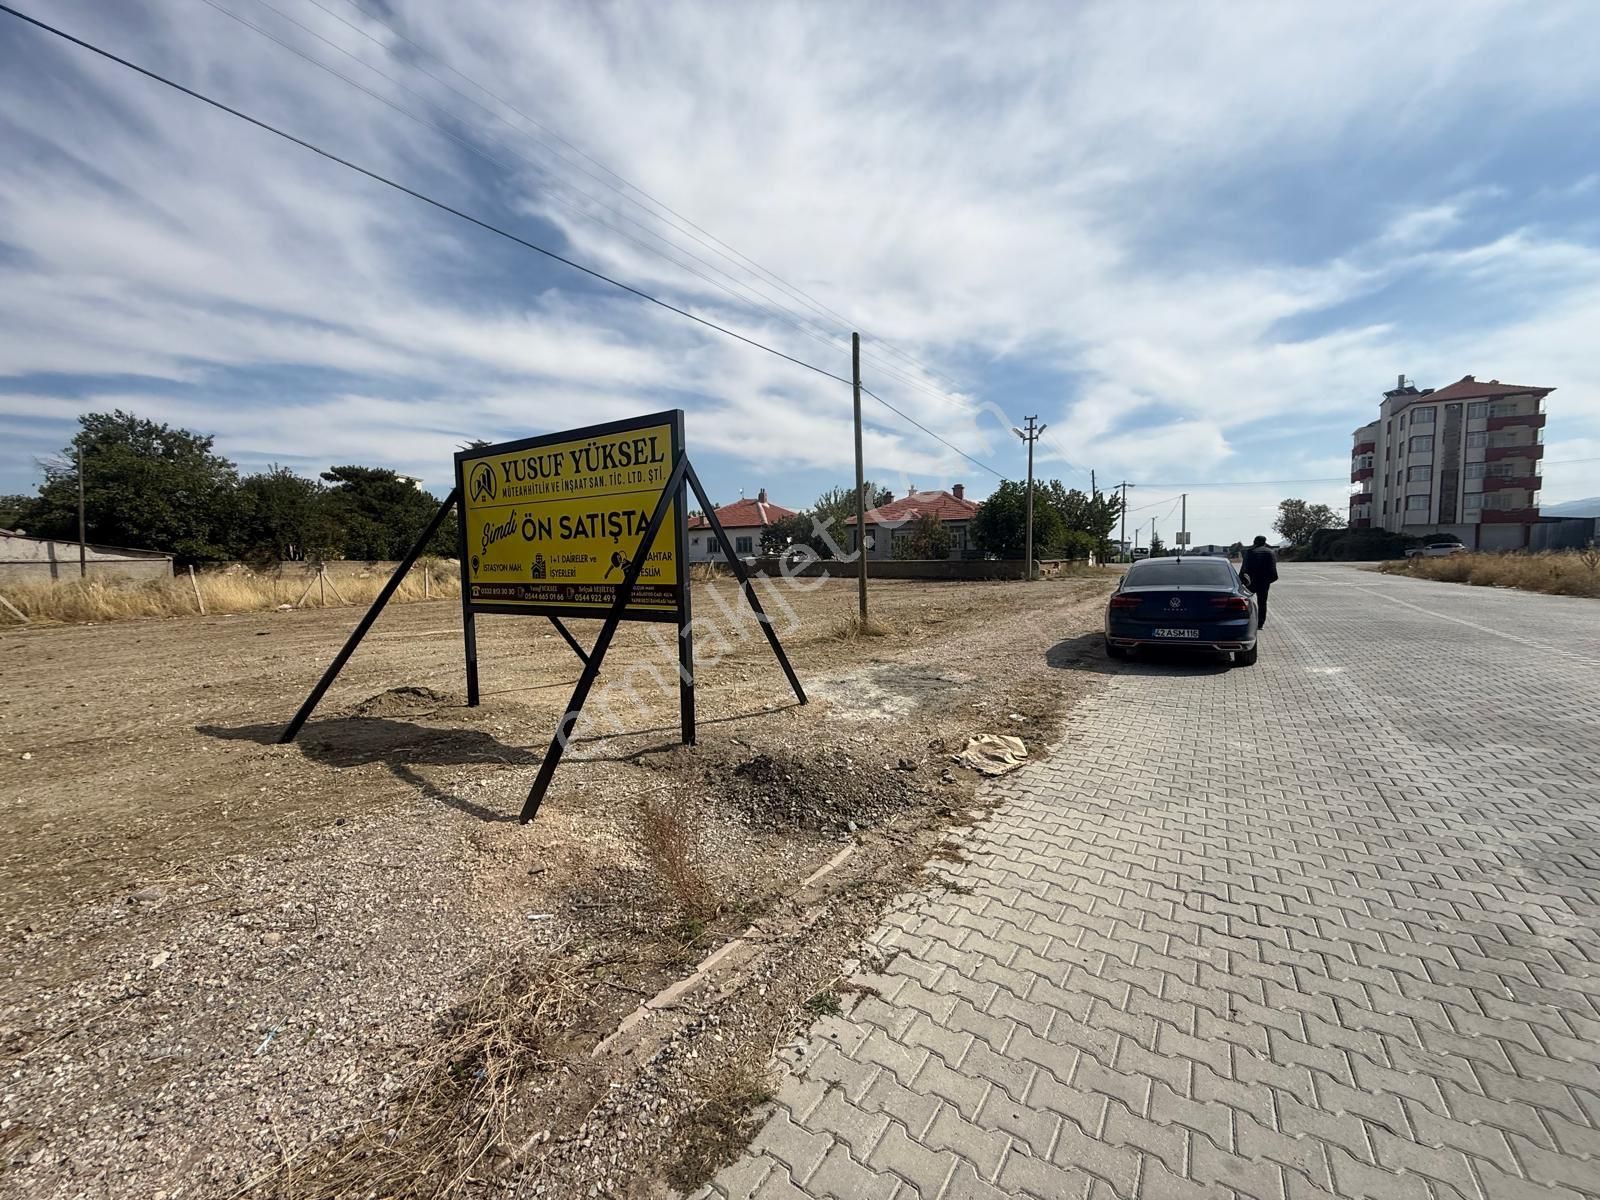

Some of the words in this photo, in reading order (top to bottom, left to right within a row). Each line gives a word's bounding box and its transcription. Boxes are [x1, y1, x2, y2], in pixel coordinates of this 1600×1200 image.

[501, 452, 565, 482] YUSUF
[569, 436, 665, 474] YÜKSEL
[502, 480, 550, 498] MÜTEAHHİTLİK
[551, 480, 560, 492] VE
[561, 478, 588, 494] İNŞAAT
[589, 476, 607, 489] SAN.
[609, 472, 625, 486] TİC.
[627, 470, 646, 485] LTD.
[481, 509, 517, 555] Şimdi
[521, 513, 552, 541] ÖN
[559, 509, 651, 544] SATIŞTA
[646, 551, 673, 561] AHTAR
[1166, 629, 1186, 637] ASM
